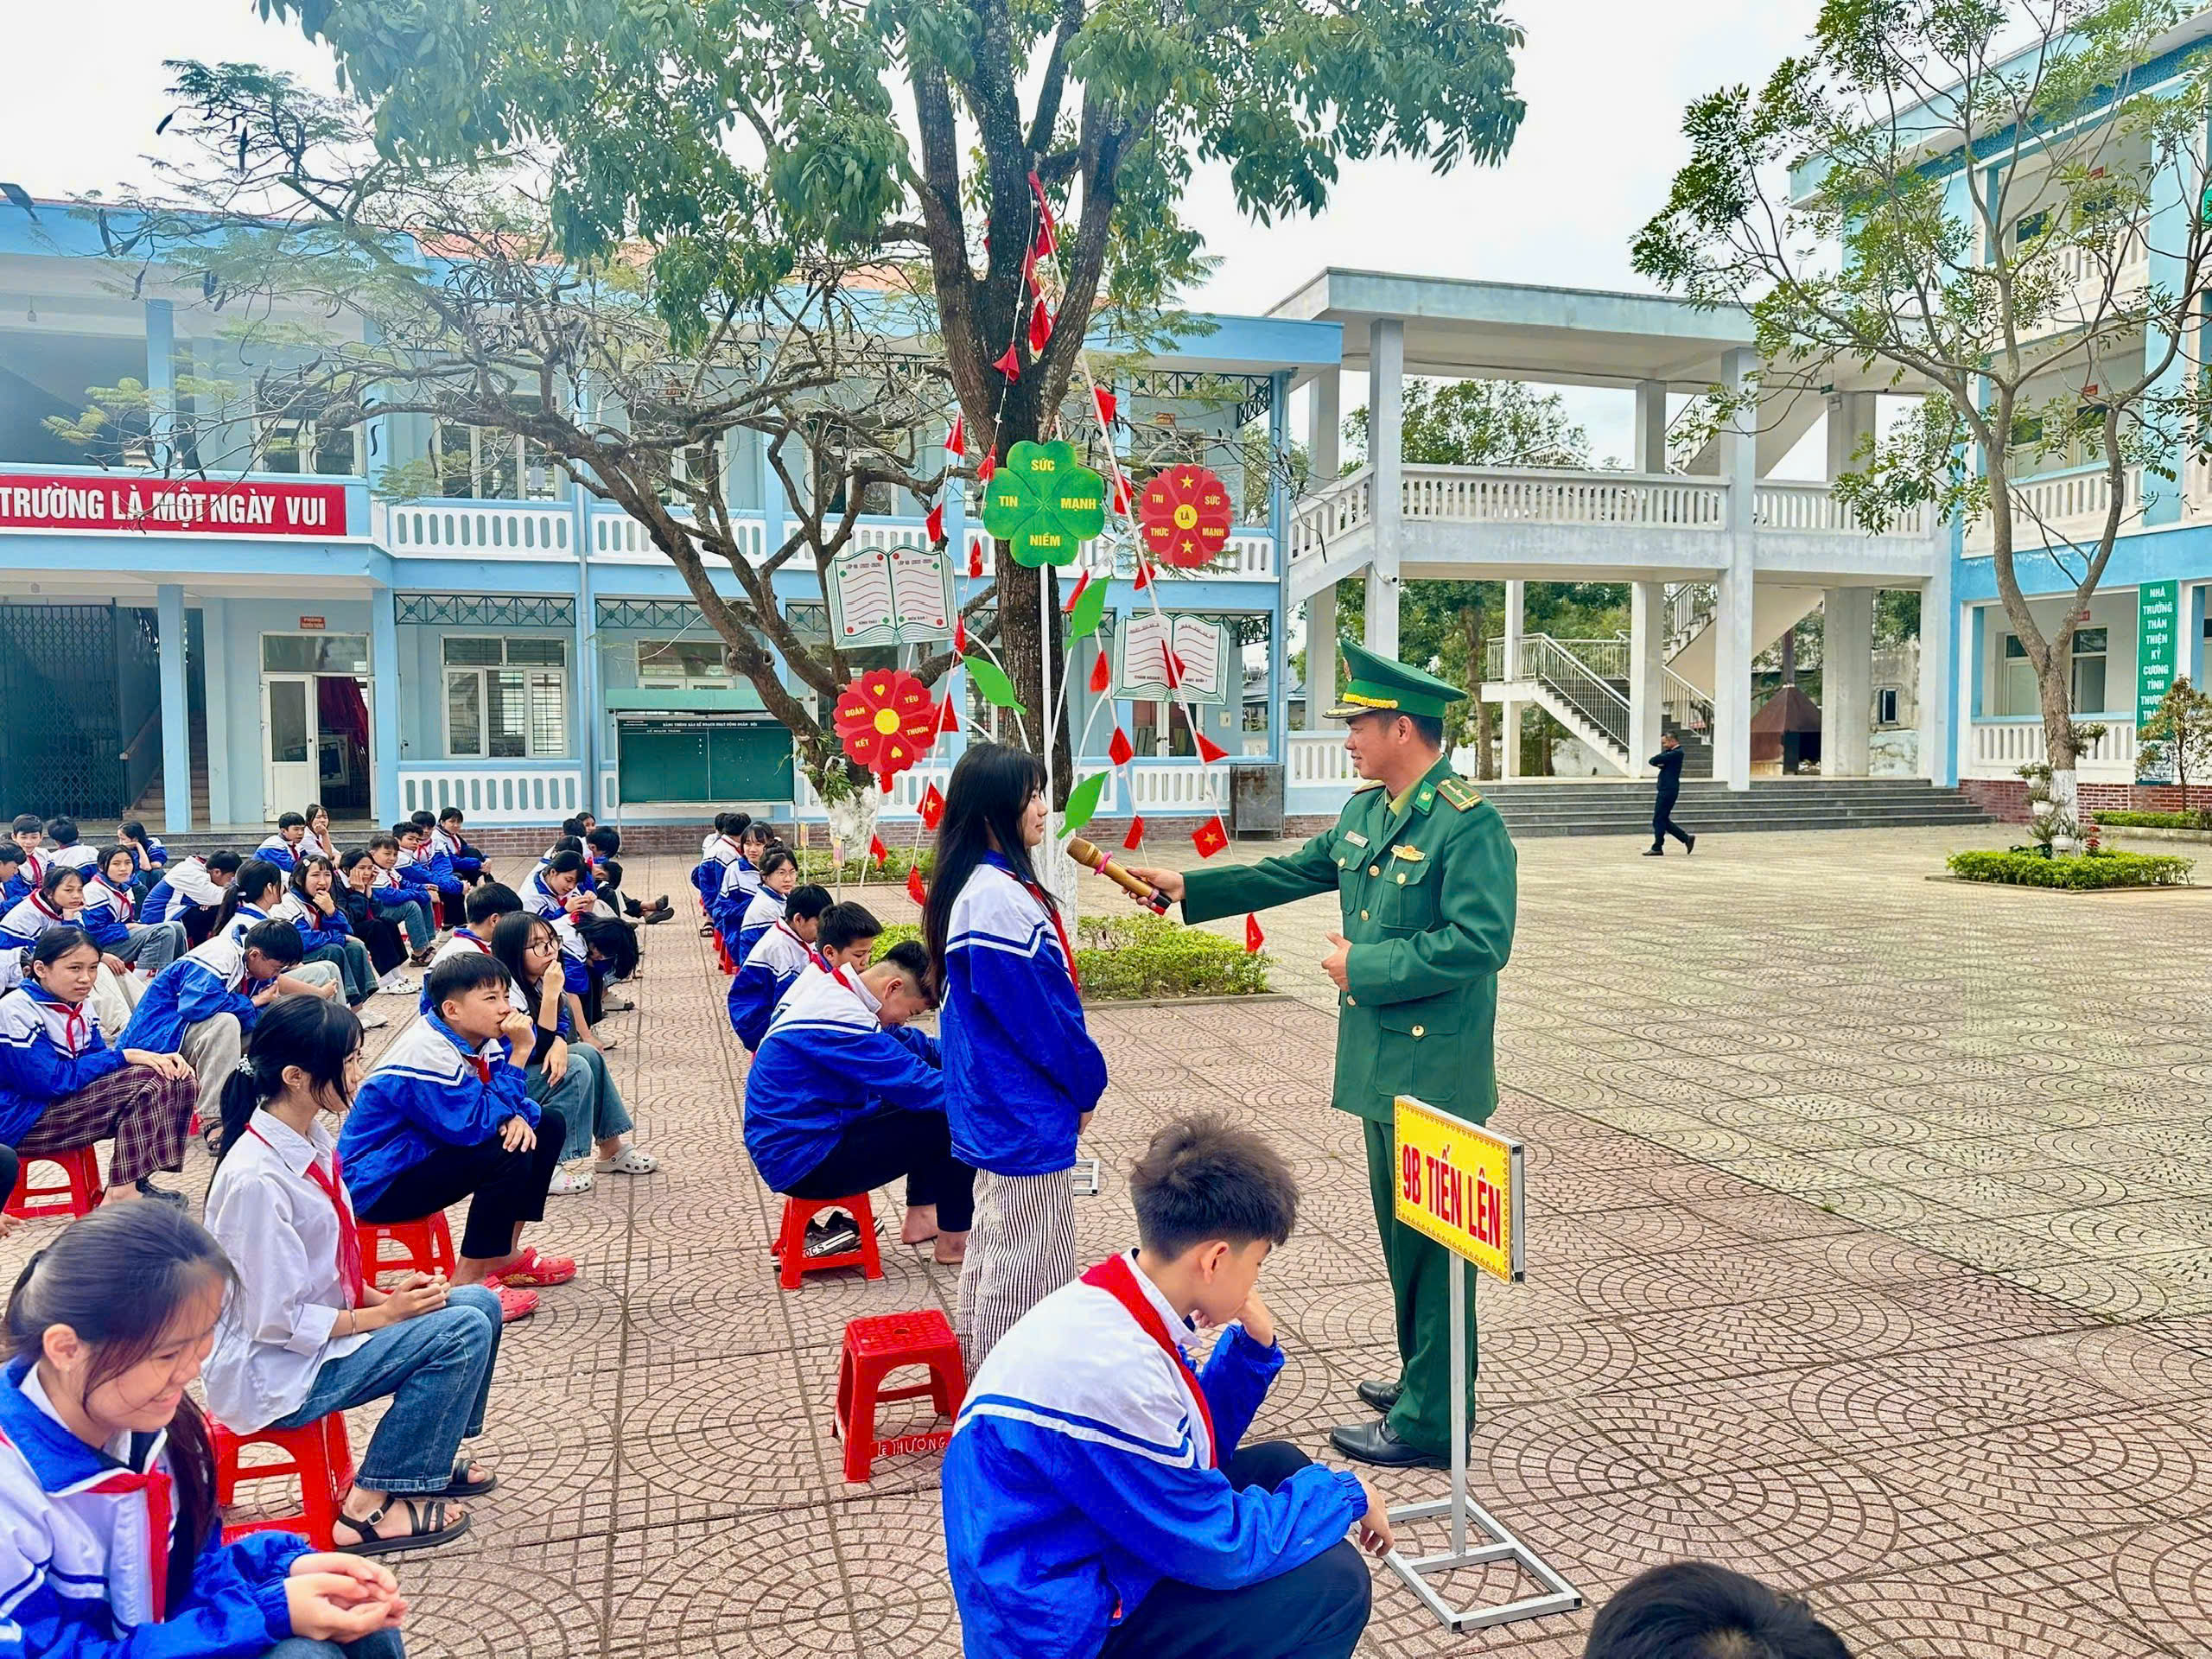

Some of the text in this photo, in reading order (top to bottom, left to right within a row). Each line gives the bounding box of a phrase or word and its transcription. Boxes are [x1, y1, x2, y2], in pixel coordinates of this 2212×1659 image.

[1031, 457, 1055, 471] SỨC
[0, 482, 327, 528] TRƯỜNG LÀ MỘT NGÀY VUI
[998, 495, 1019, 507] TIN
[1060, 498, 1096, 512] MẠNH
[1205, 493, 1221, 505] SỨC
[1029, 531, 1061, 547] NIỀM
[2150, 586, 2165, 598] NHÀ
[2143, 601, 2173, 615] TRƯỜNG
[2147, 618, 2167, 630] THÂN
[2145, 632, 2168, 645] THIỆN
[2146, 678, 2164, 690] TÌNH
[904, 695, 919, 703] YÊU
[2140, 694, 2170, 705] THƯƠN
[844, 706, 866, 717] ĐOÀN
[906, 725, 929, 735] THƯƠN
[855, 737, 869, 747] KẾT
[1402, 1143, 1501, 1250] 9B TIẾN LÊN
